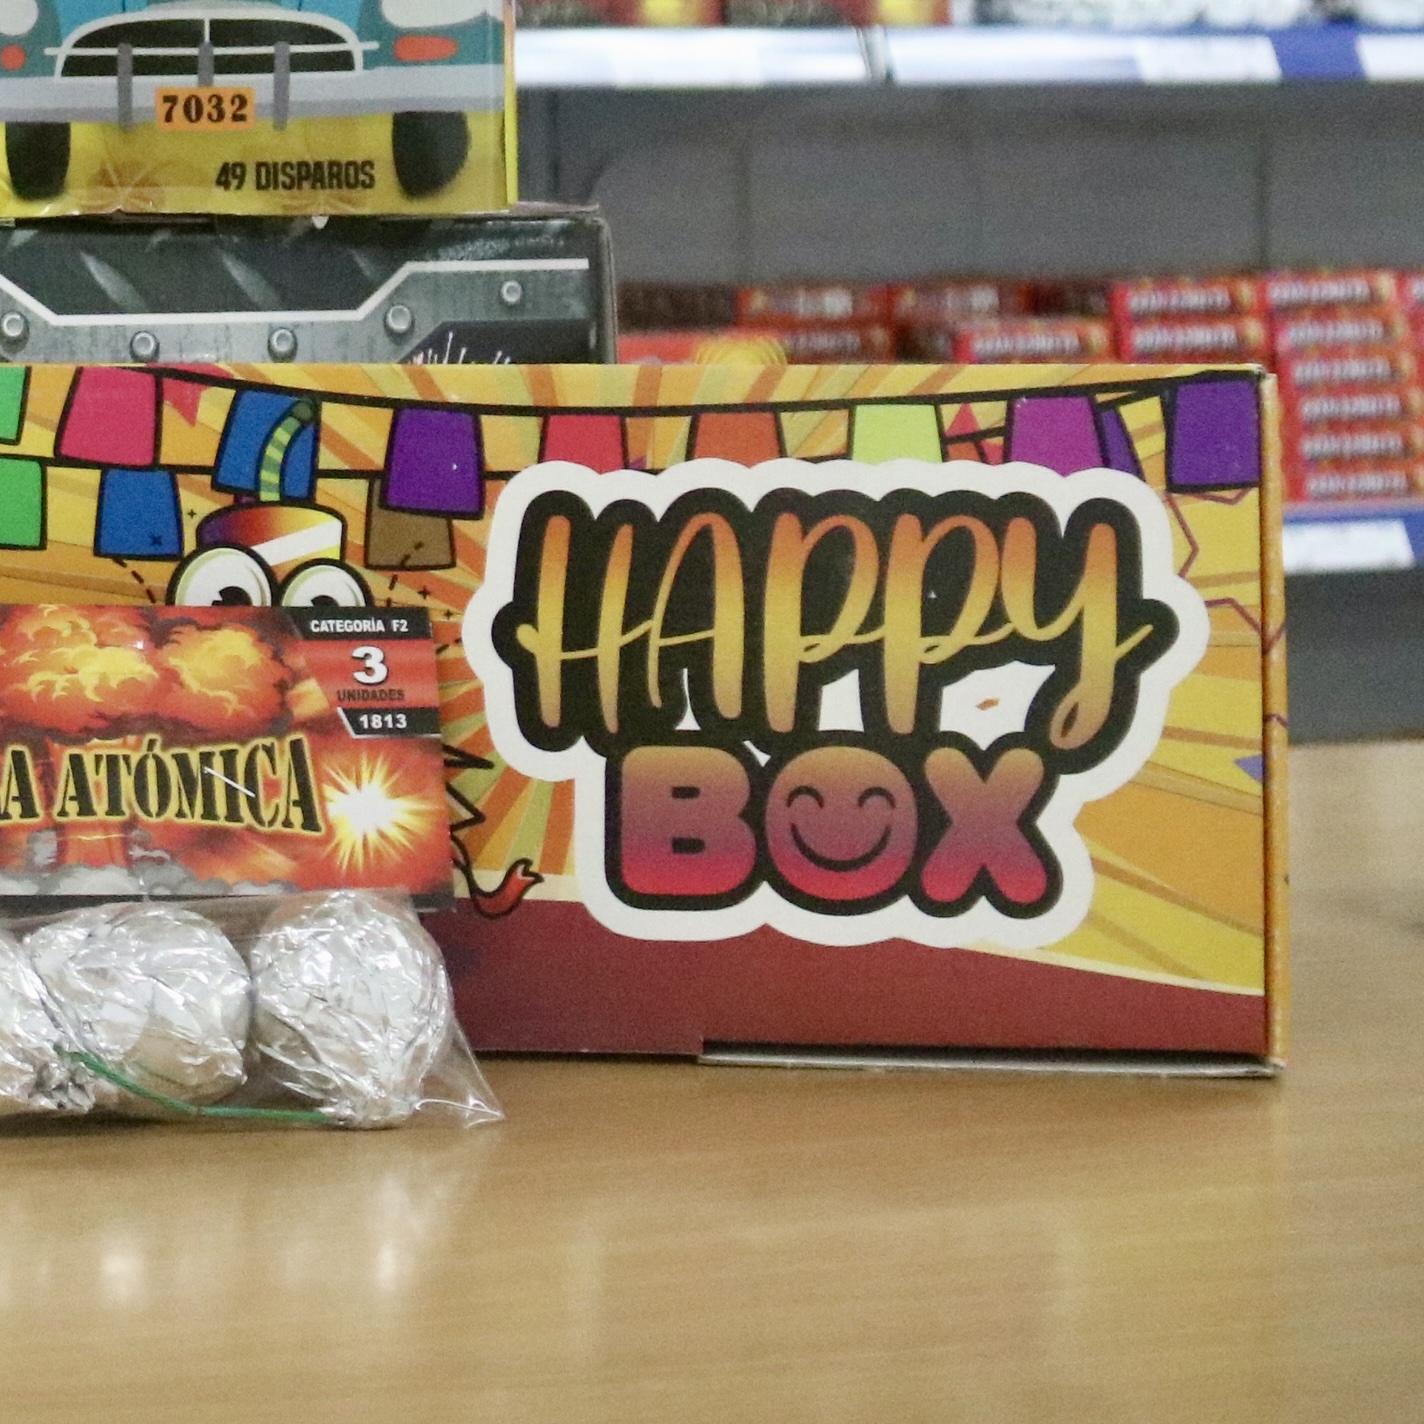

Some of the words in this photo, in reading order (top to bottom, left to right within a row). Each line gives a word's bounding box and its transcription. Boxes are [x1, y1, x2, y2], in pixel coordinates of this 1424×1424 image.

[161, 93, 249, 126] 7032
[215, 161, 247, 192] 49
[256, 158, 376, 193] DISPAROS
[308, 617, 385, 635] CATEGORÍA
[390, 618, 409, 634] F2
[352, 646, 389, 685] 3
[336, 688, 407, 703] UNIDADES
[358, 713, 409, 731] 1813
[56, 733, 328, 835] ATÓMICA
[612, 742, 1058, 910] BOX
